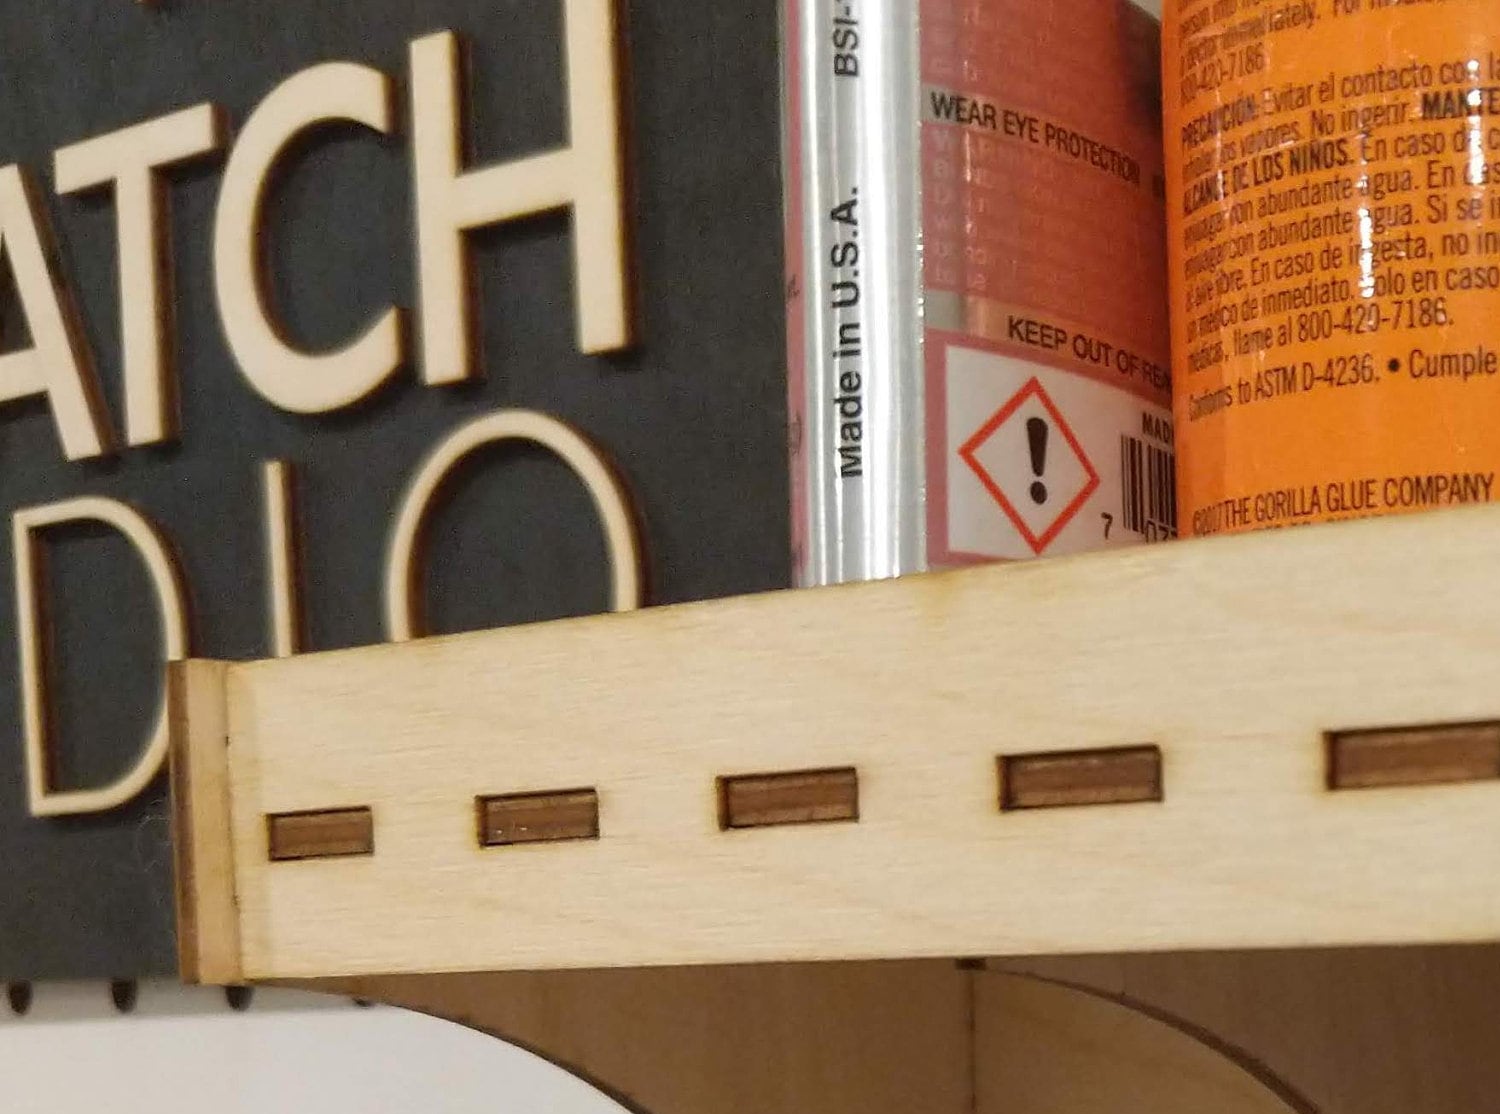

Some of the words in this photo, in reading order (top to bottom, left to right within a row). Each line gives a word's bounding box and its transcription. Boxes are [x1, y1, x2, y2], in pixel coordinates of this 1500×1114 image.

[833, 0, 860, 77] BSI-
[1318, 73, 1335, 103] el
[1341, 60, 1434, 99] contacto
[929, 91, 997, 130] WEAR
[1003, 109, 1039, 144] EYE
[1045, 122, 1141, 184] PROTECTION
[1311, 110, 1335, 137] No
[1253, 150, 1284, 187] LOS
[1394, 130, 1446, 159] caso
[1453, 124, 1481, 153] d
[1257, 173, 1351, 217] abundante
[1427, 159, 1455, 188] En
[830, 186, 861, 309] U.S.A.
[1257, 209, 1351, 250] abundante
[1358, 203, 1420, 234] gua.
[1427, 193, 1449, 223] Si
[1457, 196, 1482, 221] se
[1251, 256, 1271, 286] En
[1274, 249, 1316, 280] caso
[1320, 241, 1343, 270] de
[1442, 233, 1470, 255] no
[1261, 275, 1355, 314] inmediato.
[1360, 269, 1405, 298] olo
[1412, 268, 1439, 293] en
[1445, 265, 1500, 291] caso
[832, 321, 861, 361] in
[1008, 315, 1068, 351] KEEP
[1073, 334, 1112, 368] OUT
[1116, 349, 1139, 378] OF
[1277, 315, 1293, 347] al
[1298, 296, 1454, 343] 800-420-7186.
[1238, 378, 1251, 405] to
[1255, 364, 1298, 401] ASTM
[1302, 352, 1380, 392] D-4236.
[1409, 345, 1498, 382] Cumple
[833, 369, 864, 478] Made
[1142, 412, 1174, 444] MAD
[1223, 497, 1252, 530] THE
[1255, 485, 1322, 522] GORILLA
[1326, 479, 1379, 512] GLUE
[1383, 471, 1495, 508] COMPANY
